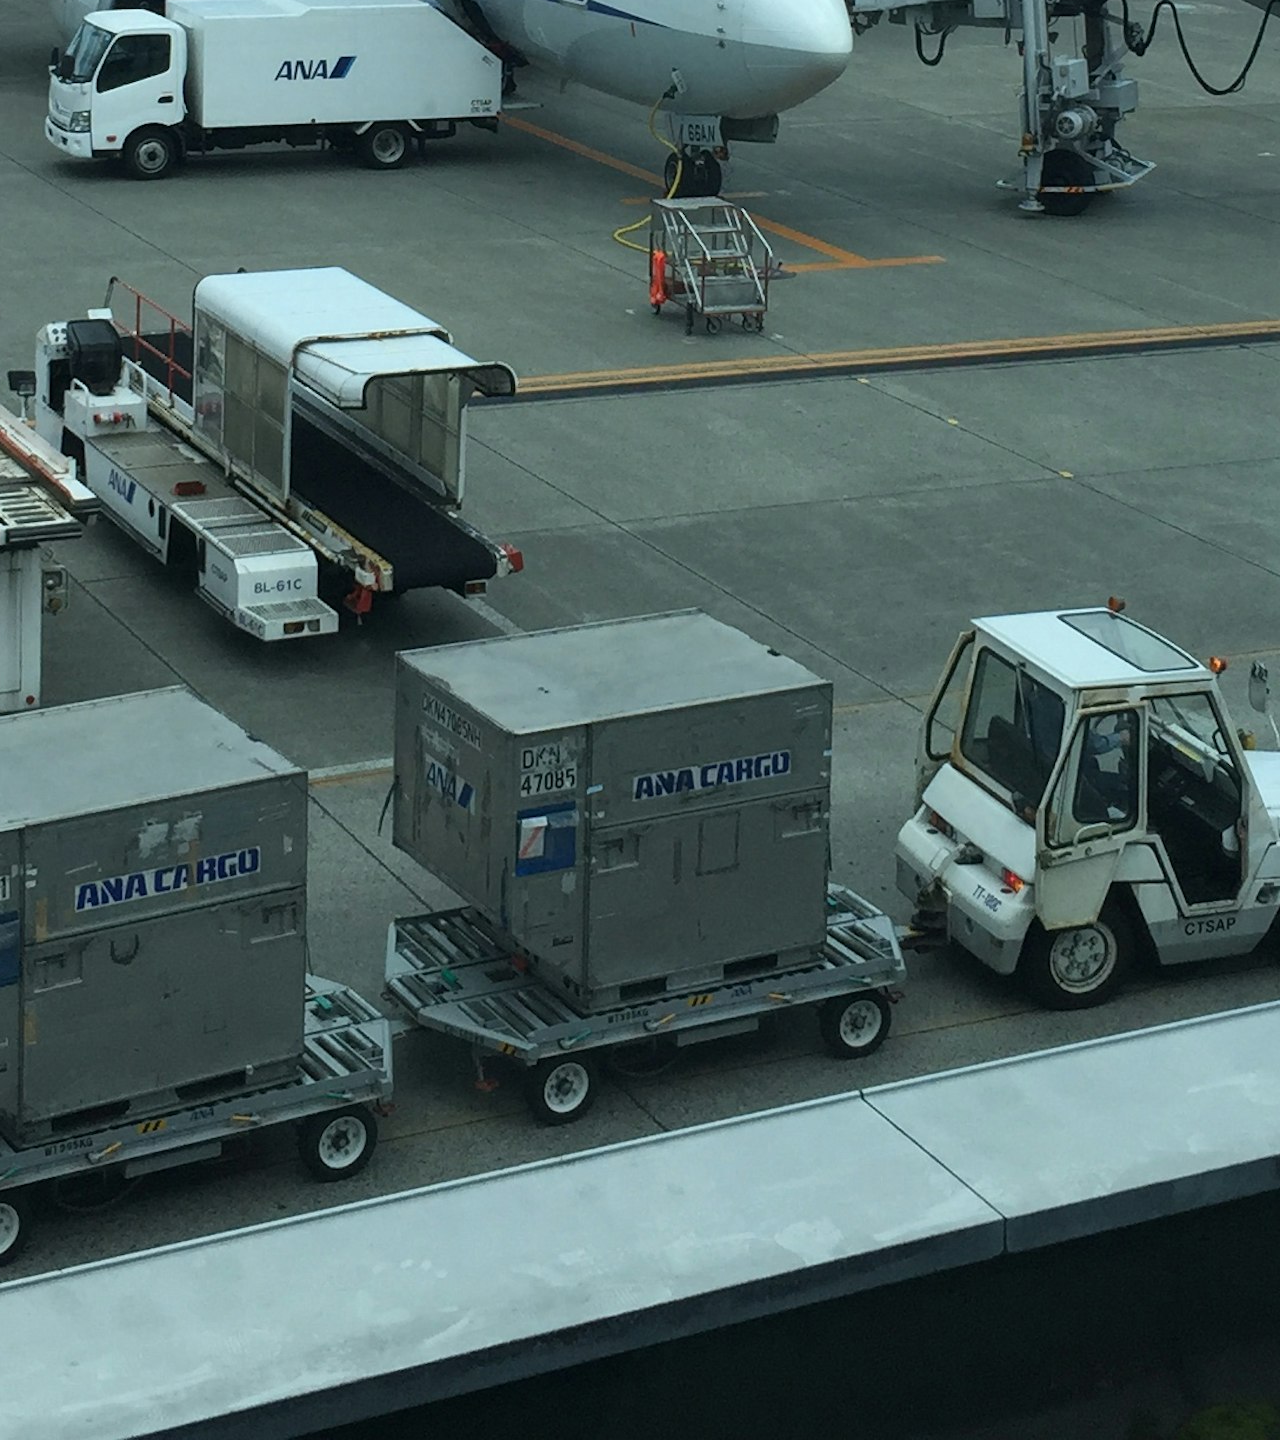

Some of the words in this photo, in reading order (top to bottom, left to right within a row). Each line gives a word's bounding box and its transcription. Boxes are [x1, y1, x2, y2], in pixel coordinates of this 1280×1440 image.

[274, 60, 329, 81] ANA
[688, 124, 716, 142] 66AN
[108, 468, 130, 502] ANA
[254, 578, 303, 594] BL-61C
[522, 745, 561, 769] DKN
[426, 762, 457, 802] ANA
[521, 768, 575, 795] 47085
[634, 768, 695, 800] ANA
[700, 751, 790, 788] CARGO
[76, 874, 148, 910] ANA
[153, 848, 260, 893] CARGO
[1184, 917, 1237, 936] CTSAP
